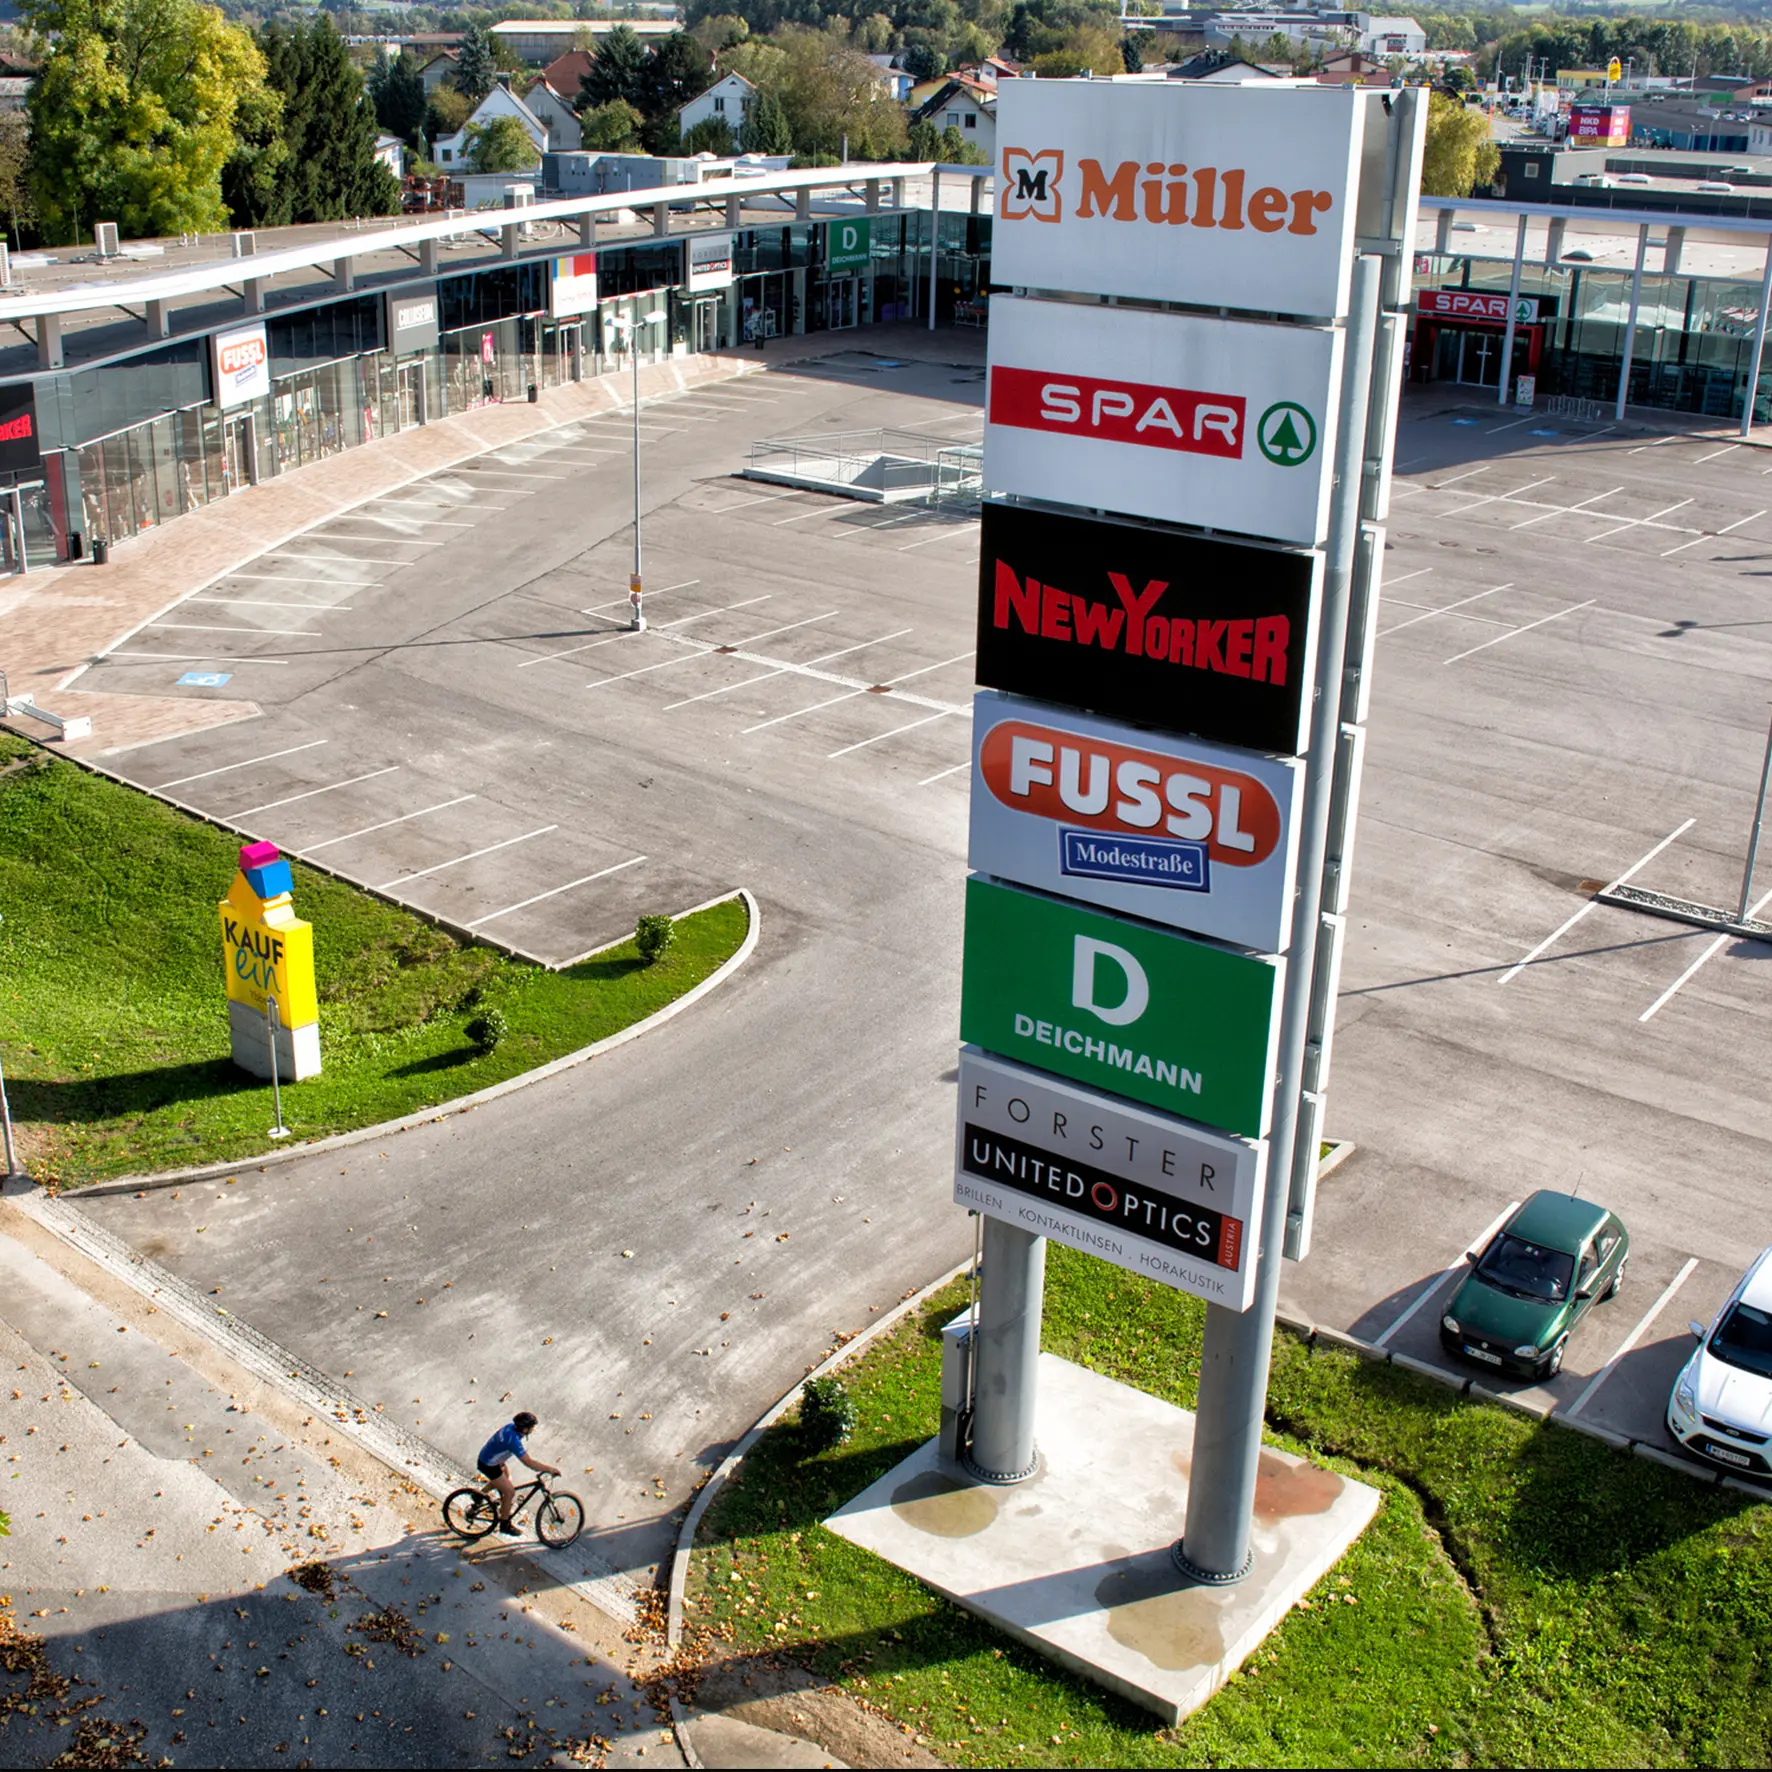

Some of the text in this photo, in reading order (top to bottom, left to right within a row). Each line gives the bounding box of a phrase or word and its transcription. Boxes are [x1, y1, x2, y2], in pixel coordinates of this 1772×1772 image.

[1578, 126, 1599, 136] BIPA
[1075, 158, 1332, 236] Müller
[1435, 294, 1505, 316] SPAR
[224, 341, 264, 371] FUSSL
[1041, 383, 1238, 446] SPAR
[1010, 735, 1256, 853] FUSSL
[1076, 842, 1193, 875] Modestraße
[224, 916, 284, 966] KAUF
[235, 947, 282, 994] ein
[1072, 933, 1149, 1026] D
[1014, 1013, 1203, 1095] DEICHMANN
[975, 1085, 1216, 1192] FORSTER
[956, 1183, 1003, 1210] BRILLEN
[1018, 1206, 1123, 1256] KONTAKTLINSEN
[1224, 1222, 1237, 1266] AUSTRIA
